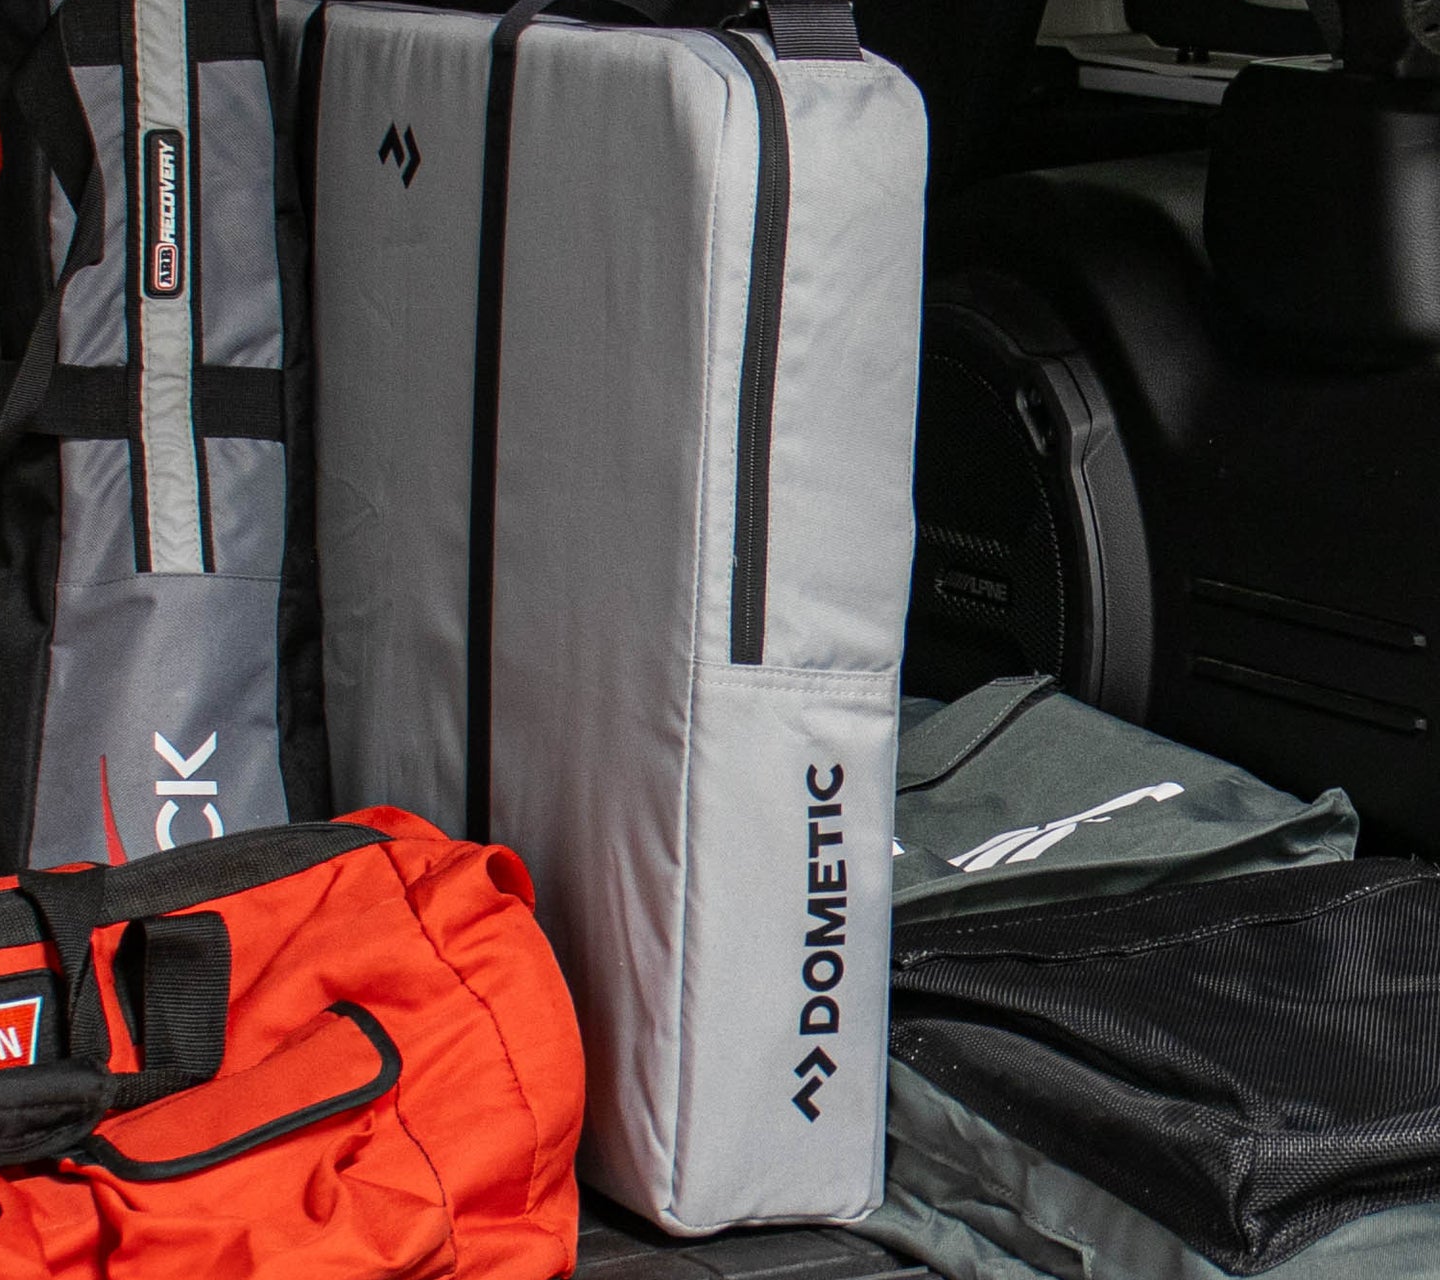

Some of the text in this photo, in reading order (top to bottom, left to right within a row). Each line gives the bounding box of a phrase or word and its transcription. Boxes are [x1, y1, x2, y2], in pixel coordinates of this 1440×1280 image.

[159, 140, 176, 285] ARB RECOVERY
[800, 763, 847, 1035] DOMETIC
